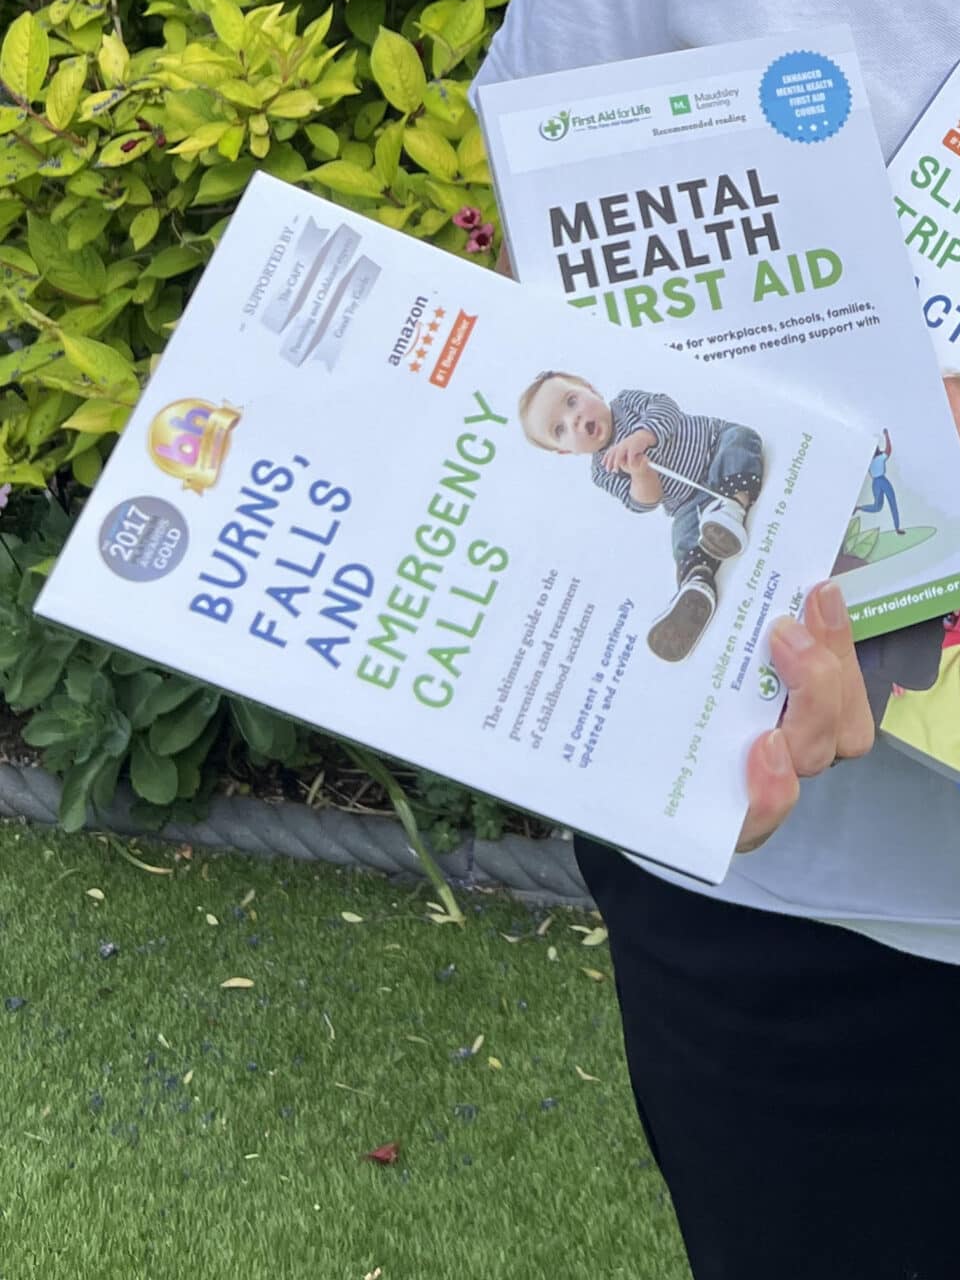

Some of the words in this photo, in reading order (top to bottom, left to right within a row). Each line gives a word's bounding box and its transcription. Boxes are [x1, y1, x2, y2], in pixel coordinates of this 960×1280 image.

[571, 112, 596, 126] First
[597, 109, 615, 122] Aid
[617, 107, 630, 118] for
[630, 103, 650, 116] Life
[652, 119, 713, 136] Recommended
[714, 114, 746, 126] reading
[693, 86, 739, 103] Maudsley
[550, 169, 779, 248] MENTAL
[242, 242, 287, 316] SUPPORTED
[278, 225, 295, 243] BY
[556, 212, 780, 293] HEALTH
[753, 248, 843, 302] AID
[388, 296, 429, 367] amazon
[686, 337, 704, 350] for
[707, 322, 777, 345] workplaces,
[779, 311, 825, 330] schools,
[827, 301, 875, 320] families,
[703, 343, 757, 362] everyone
[759, 333, 806, 352] needing
[808, 322, 853, 341] support
[855, 314, 880, 328] with
[107, 503, 152, 563] 2017
[151, 525, 183, 571] GOLD
[189, 454, 310, 623] BURNS,
[249, 479, 352, 648] FALLS
[357, 390, 509, 690] EMERGENCY
[536, 593, 549, 608] to
[541, 568, 559, 590] the
[305, 562, 374, 669] AND
[412, 538, 510, 709] CALLS
[522, 608, 543, 647] guide
[566, 603, 595, 664] accidents
[664, 767, 693, 818] Helping
[685, 734, 702, 763] you
[695, 695, 717, 730] keep
[711, 635, 738, 690] children
[746, 558, 766, 594] from
[758, 518, 780, 555] birth
[775, 500, 787, 516] to
[783, 432, 813, 496] adulthood
[731, 655, 750, 692] Emma
[744, 602, 770, 654] Hammett
[763, 571, 782, 603] RGN
[497, 647, 525, 703] ultimate
[509, 669, 543, 742] prevention
[539, 640, 554, 668] and
[550, 576, 581, 640] treatment
[563, 743, 577, 763] All
[592, 671, 605, 684] is
[600, 597, 635, 667] continually
[483, 705, 503, 730] The
[535, 663, 571, 733] childhood
[579, 714, 606, 769] updated
[602, 685, 617, 711] and
[612, 633, 638, 683] revised.
[531, 730, 544, 750] of
